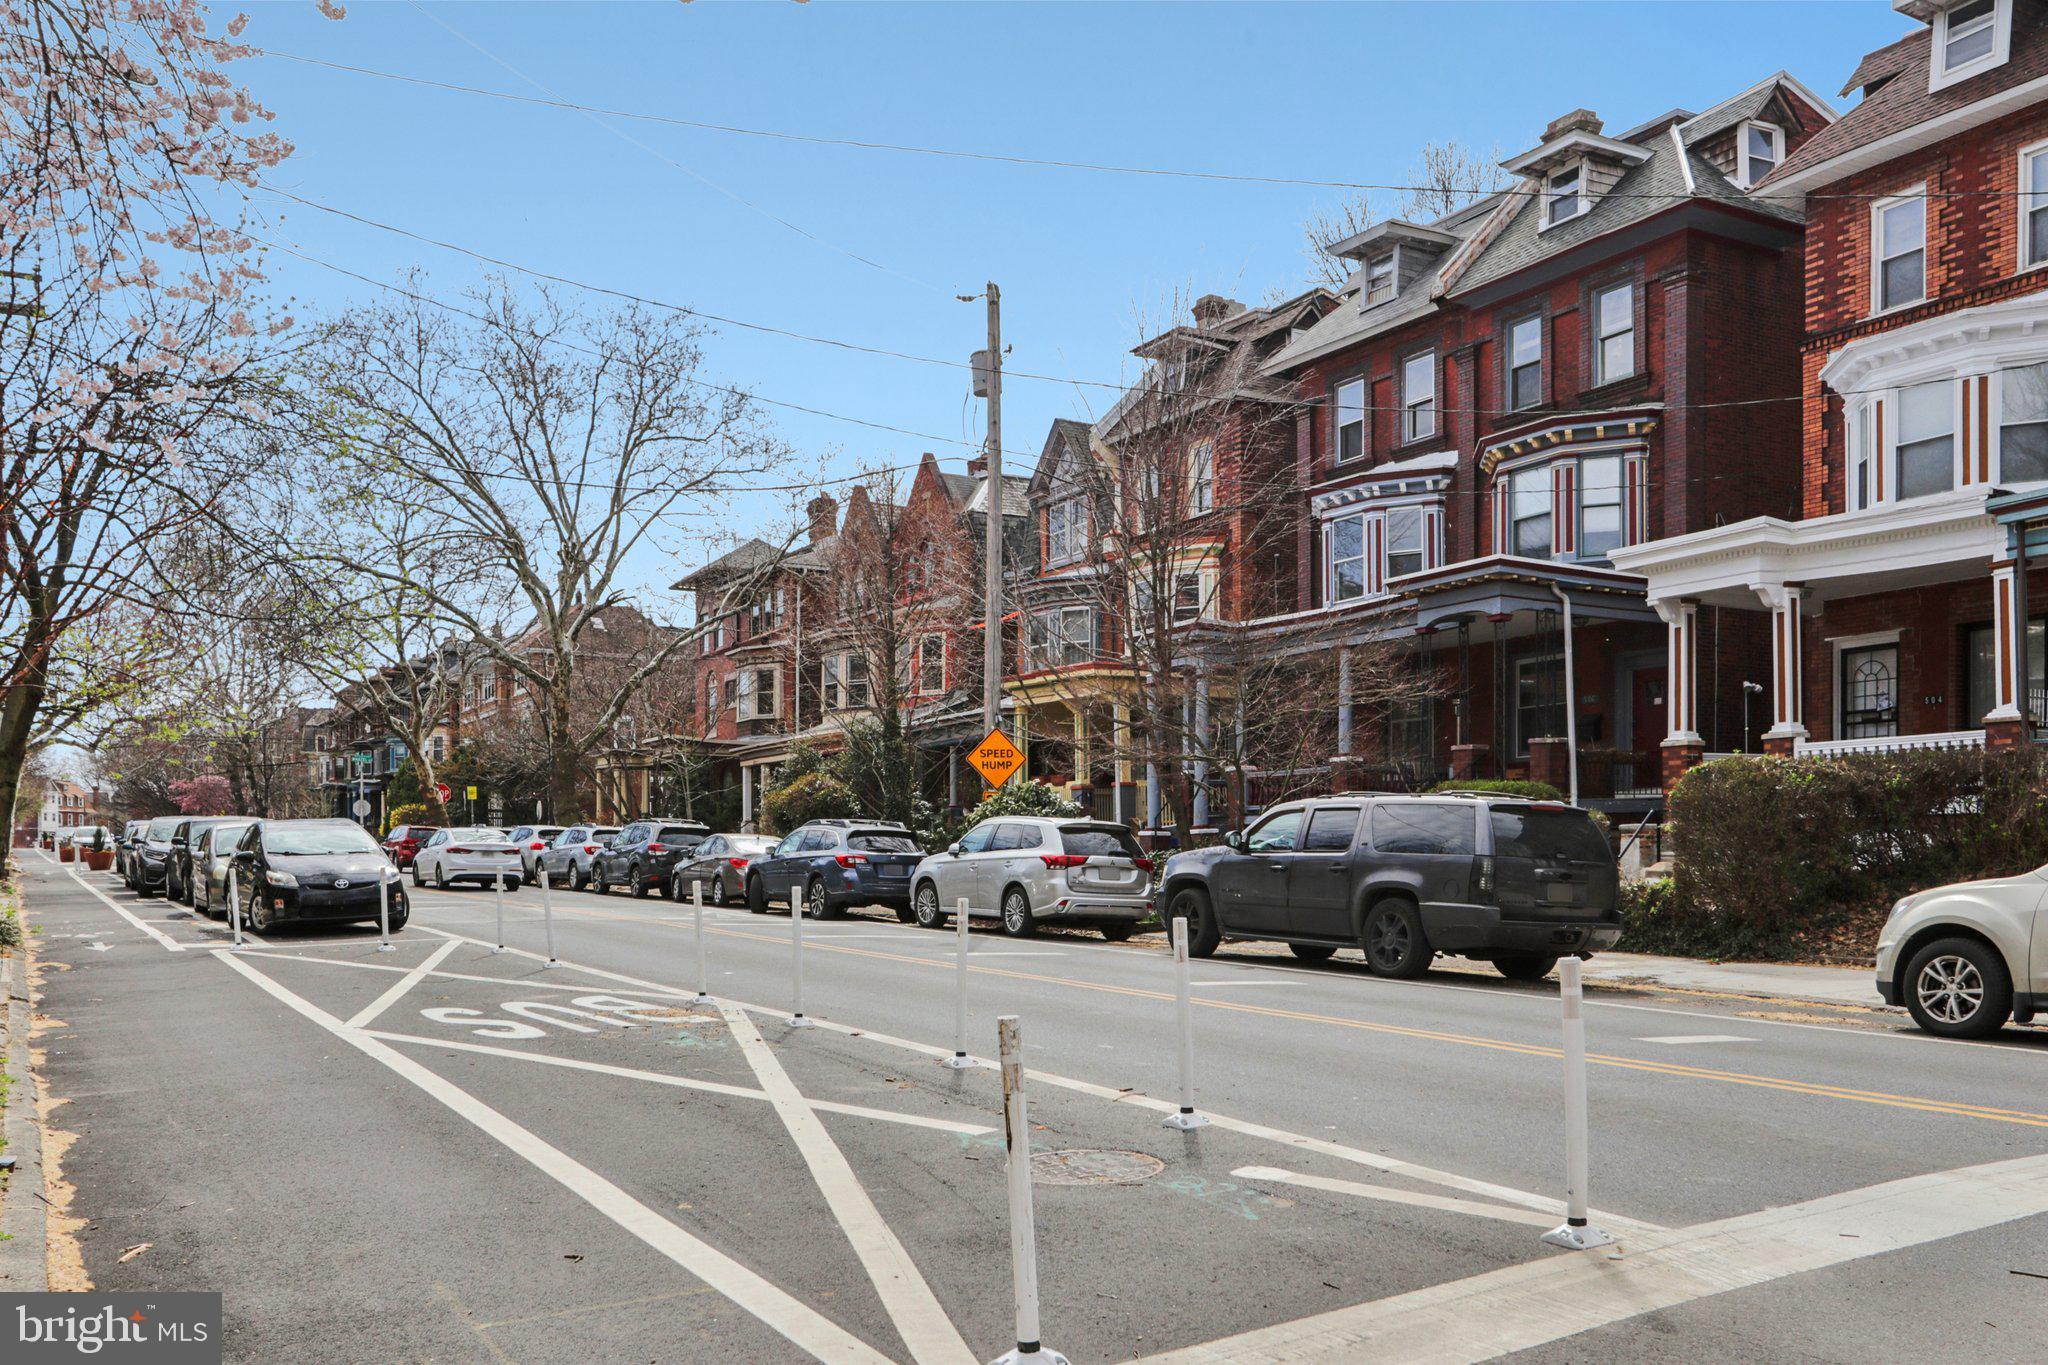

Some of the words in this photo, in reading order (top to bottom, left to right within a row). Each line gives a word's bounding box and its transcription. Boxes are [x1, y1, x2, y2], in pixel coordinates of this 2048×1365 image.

[980, 749, 1014, 758] SPEED
[981, 761, 1012, 769] HUMP
[420, 996, 722, 1039] BUS
